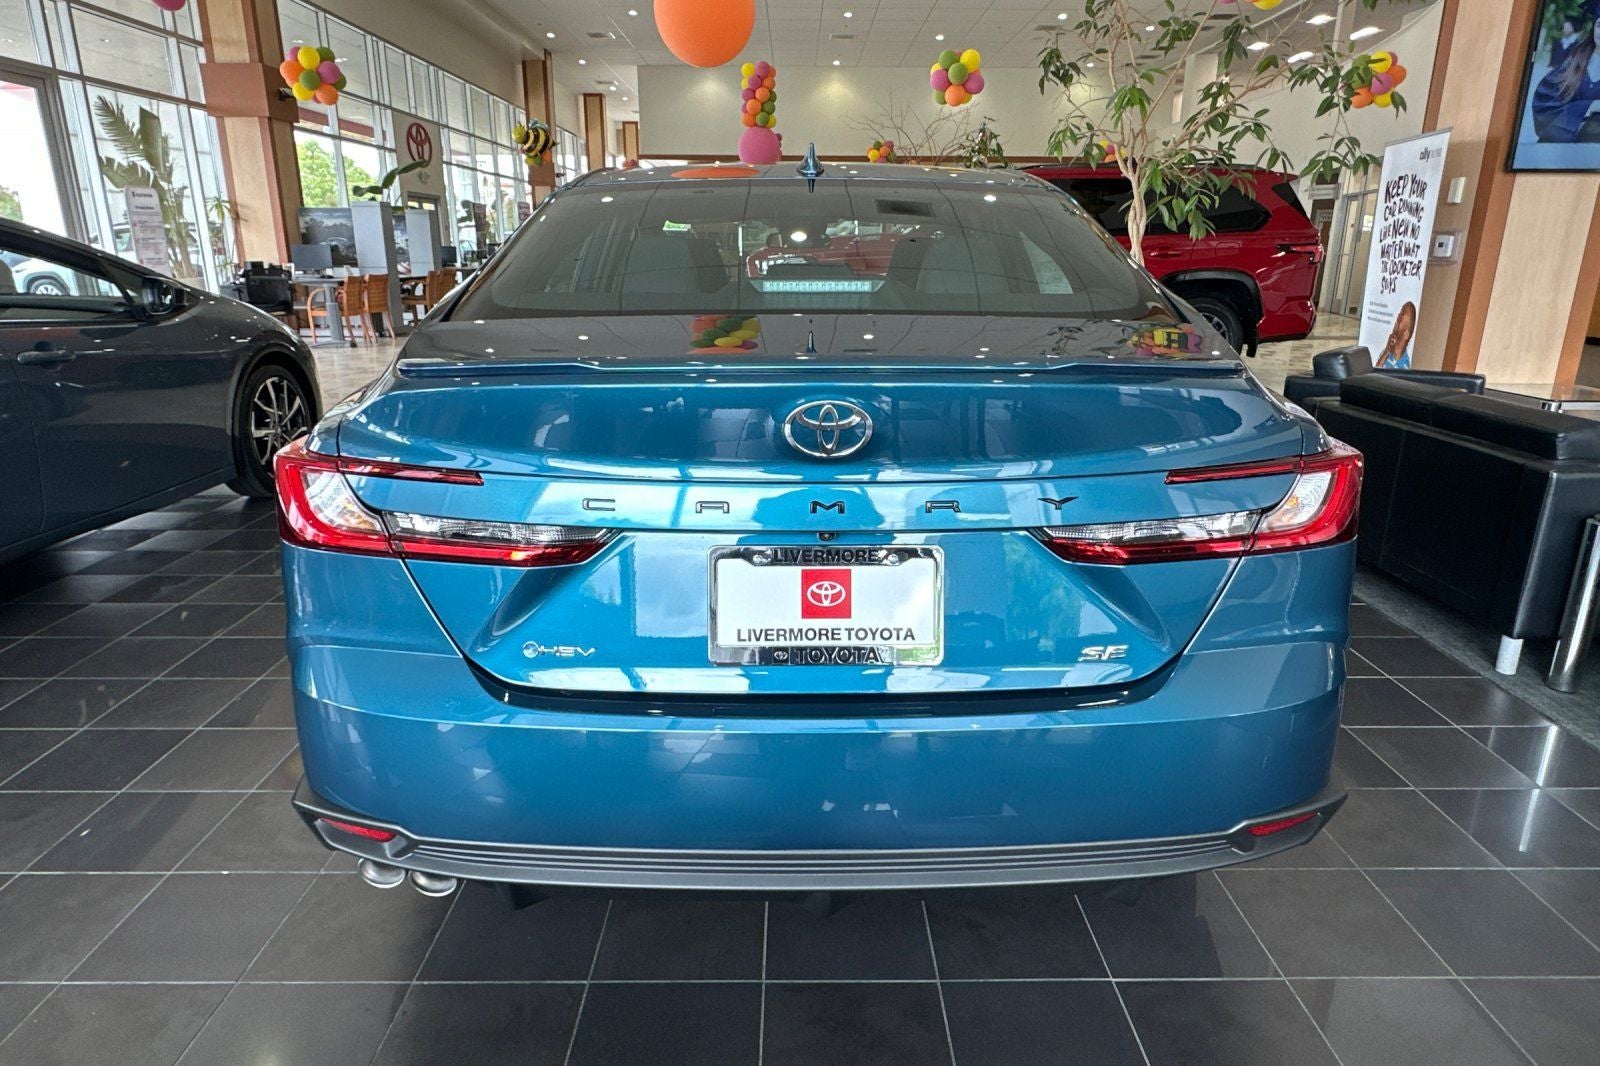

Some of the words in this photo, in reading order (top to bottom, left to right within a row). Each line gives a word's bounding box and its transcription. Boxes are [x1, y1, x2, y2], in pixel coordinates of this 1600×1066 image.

[582, 496, 1079, 514] CAMRY
[772, 549, 879, 564] LIVERMORE
[736, 628, 842, 642] LIVERMORE
[845, 628, 916, 641] TOYOTA
[794, 647, 882, 665] TOYOTA
[1077, 644, 1129, 661] SE
